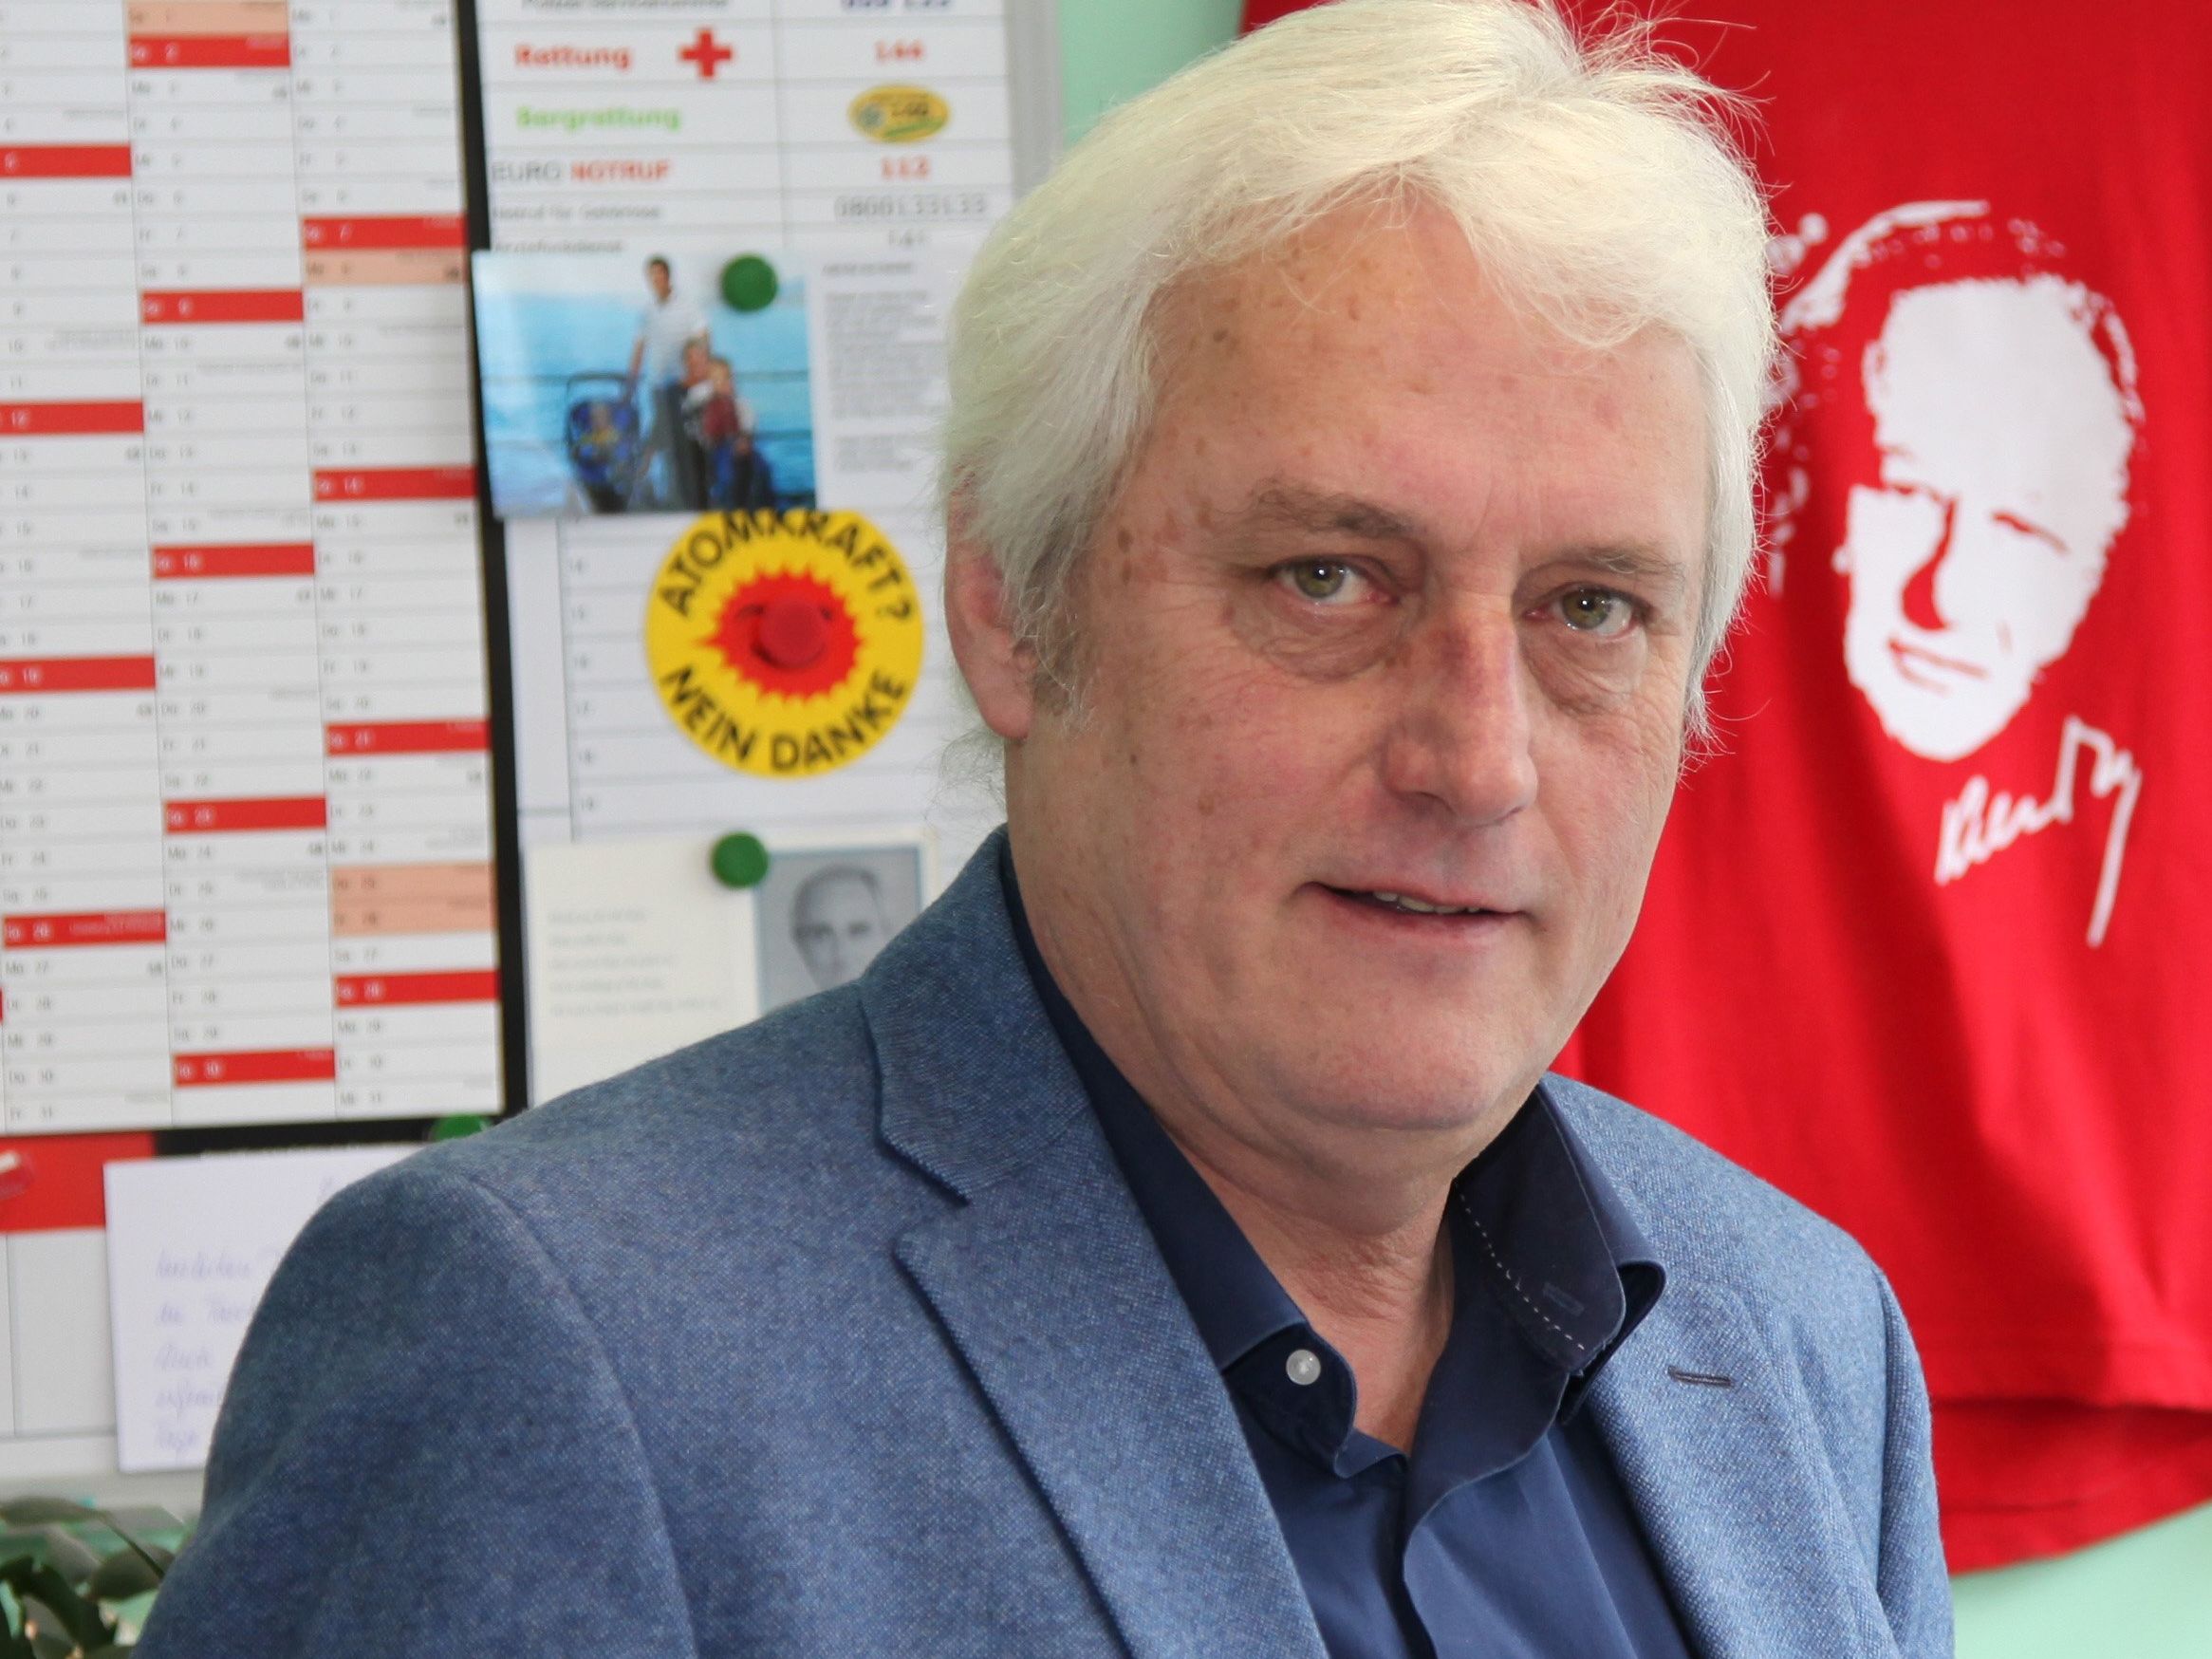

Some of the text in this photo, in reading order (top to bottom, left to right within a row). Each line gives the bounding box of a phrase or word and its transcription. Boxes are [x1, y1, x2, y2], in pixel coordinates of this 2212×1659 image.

[492, 158, 670, 182] EURO NOTRUF
[881, 155, 930, 179] 112
[661, 666, 906, 774] NEIN DANKE
